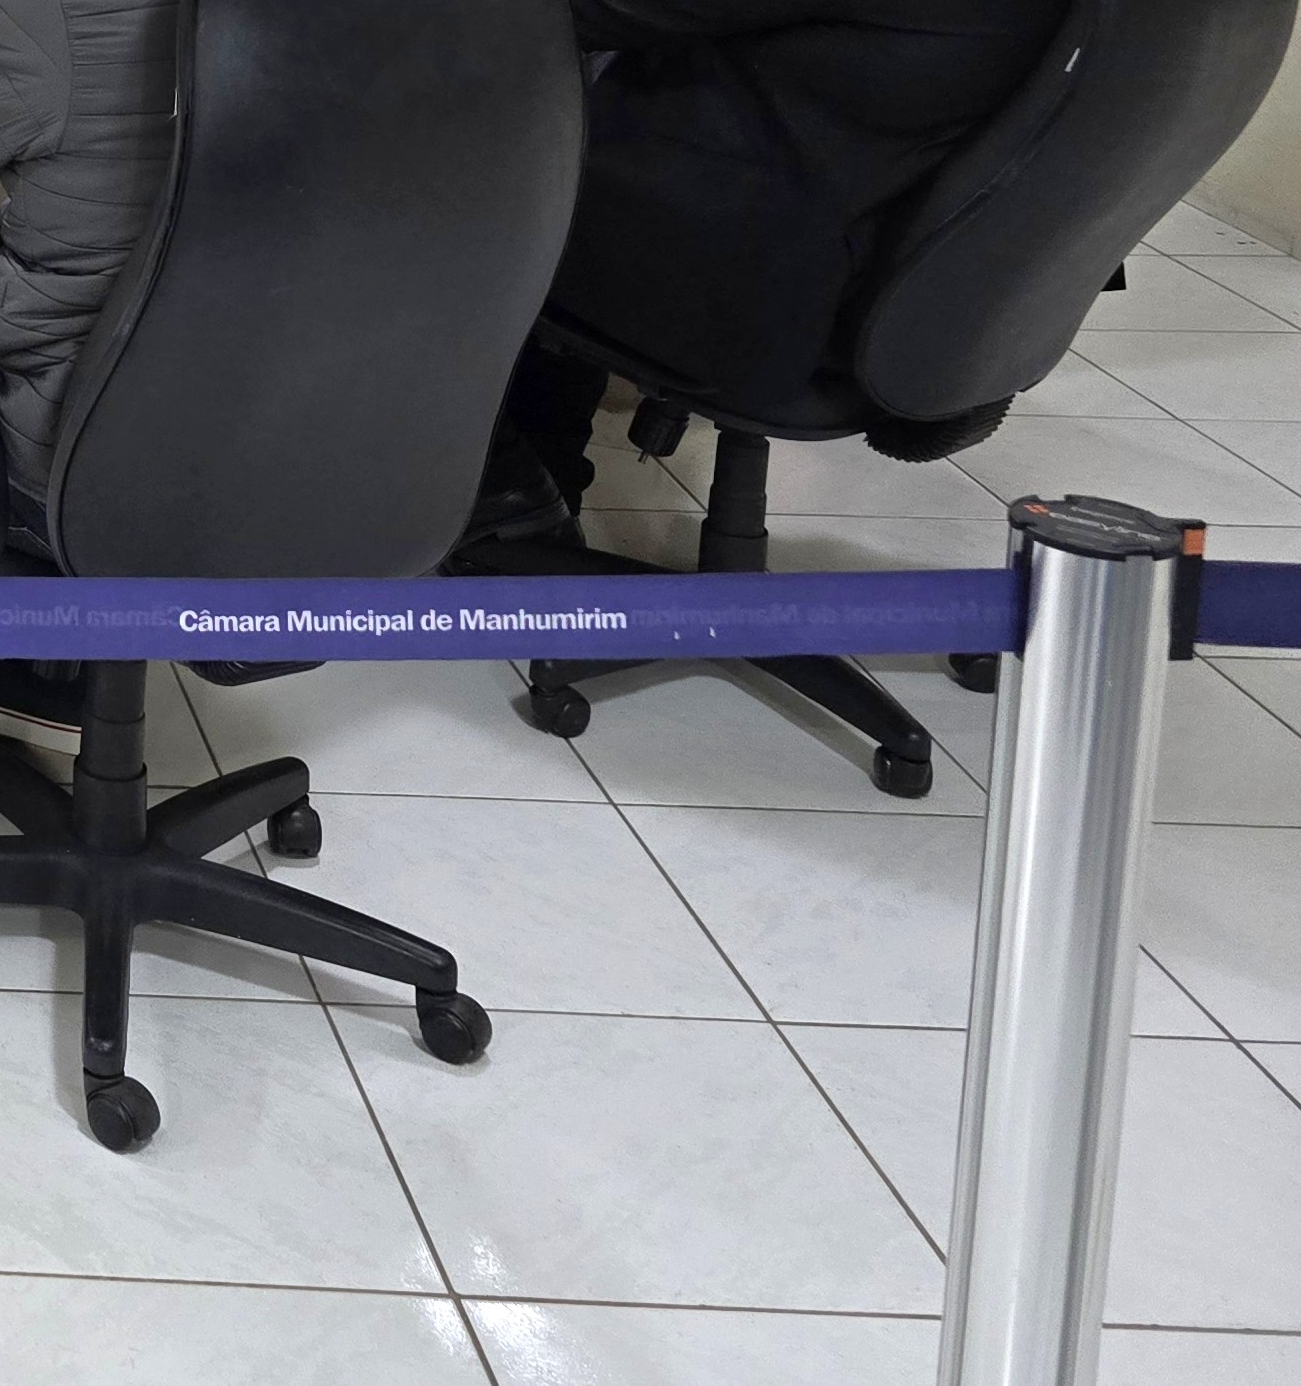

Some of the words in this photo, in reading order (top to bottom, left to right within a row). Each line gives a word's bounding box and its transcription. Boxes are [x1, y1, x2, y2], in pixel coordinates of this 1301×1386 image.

[178, 608, 281, 633] Câmara
[286, 609, 414, 636] Municipal
[420, 609, 453, 632] de
[459, 607, 627, 631] Manhumirim
